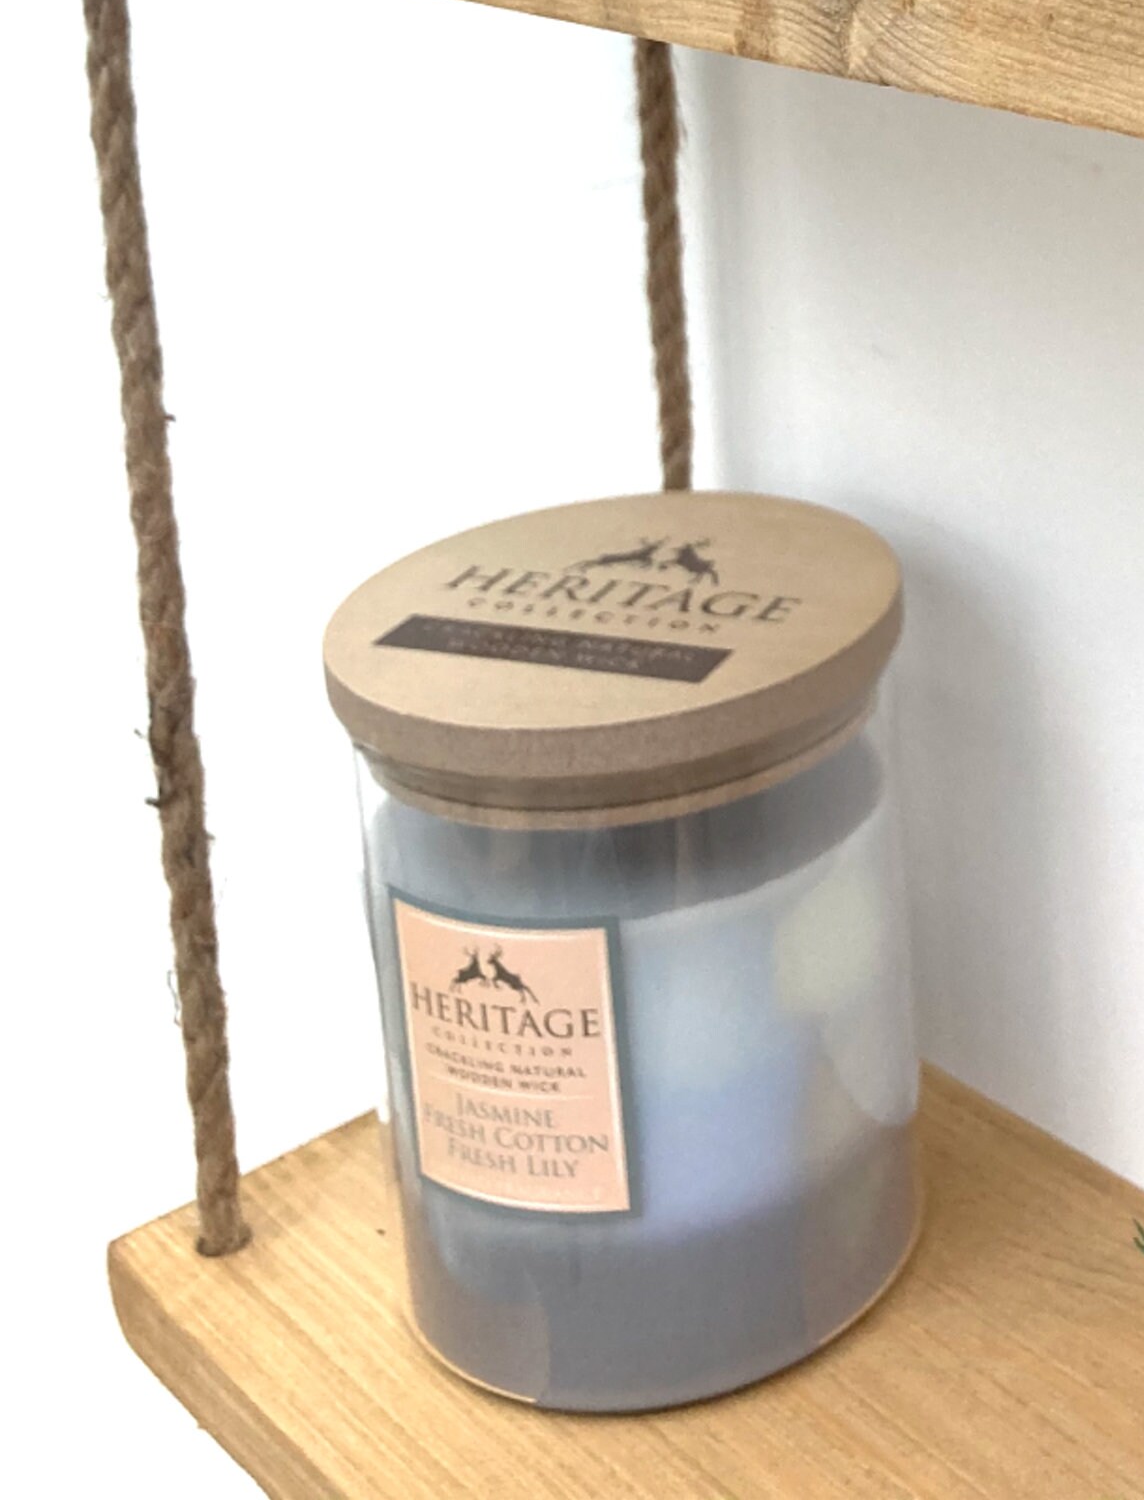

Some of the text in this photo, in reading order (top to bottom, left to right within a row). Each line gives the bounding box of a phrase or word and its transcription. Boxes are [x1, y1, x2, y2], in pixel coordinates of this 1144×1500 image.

[445, 565, 801, 622] HERITAGE
[467, 597, 720, 633] COLLECTION
[410, 981, 600, 1039] HERITAGE
[432, 1025, 572, 1056] COLLECTION
[425, 1042, 586, 1078] CRACKLING NATURAL
[447, 1065, 560, 1093] WOODEN WICK
[423, 1102, 609, 1153] FRESH COTTON
[456, 1093, 555, 1129] JASMINE
[448, 1137, 578, 1178] FRESH LILY
